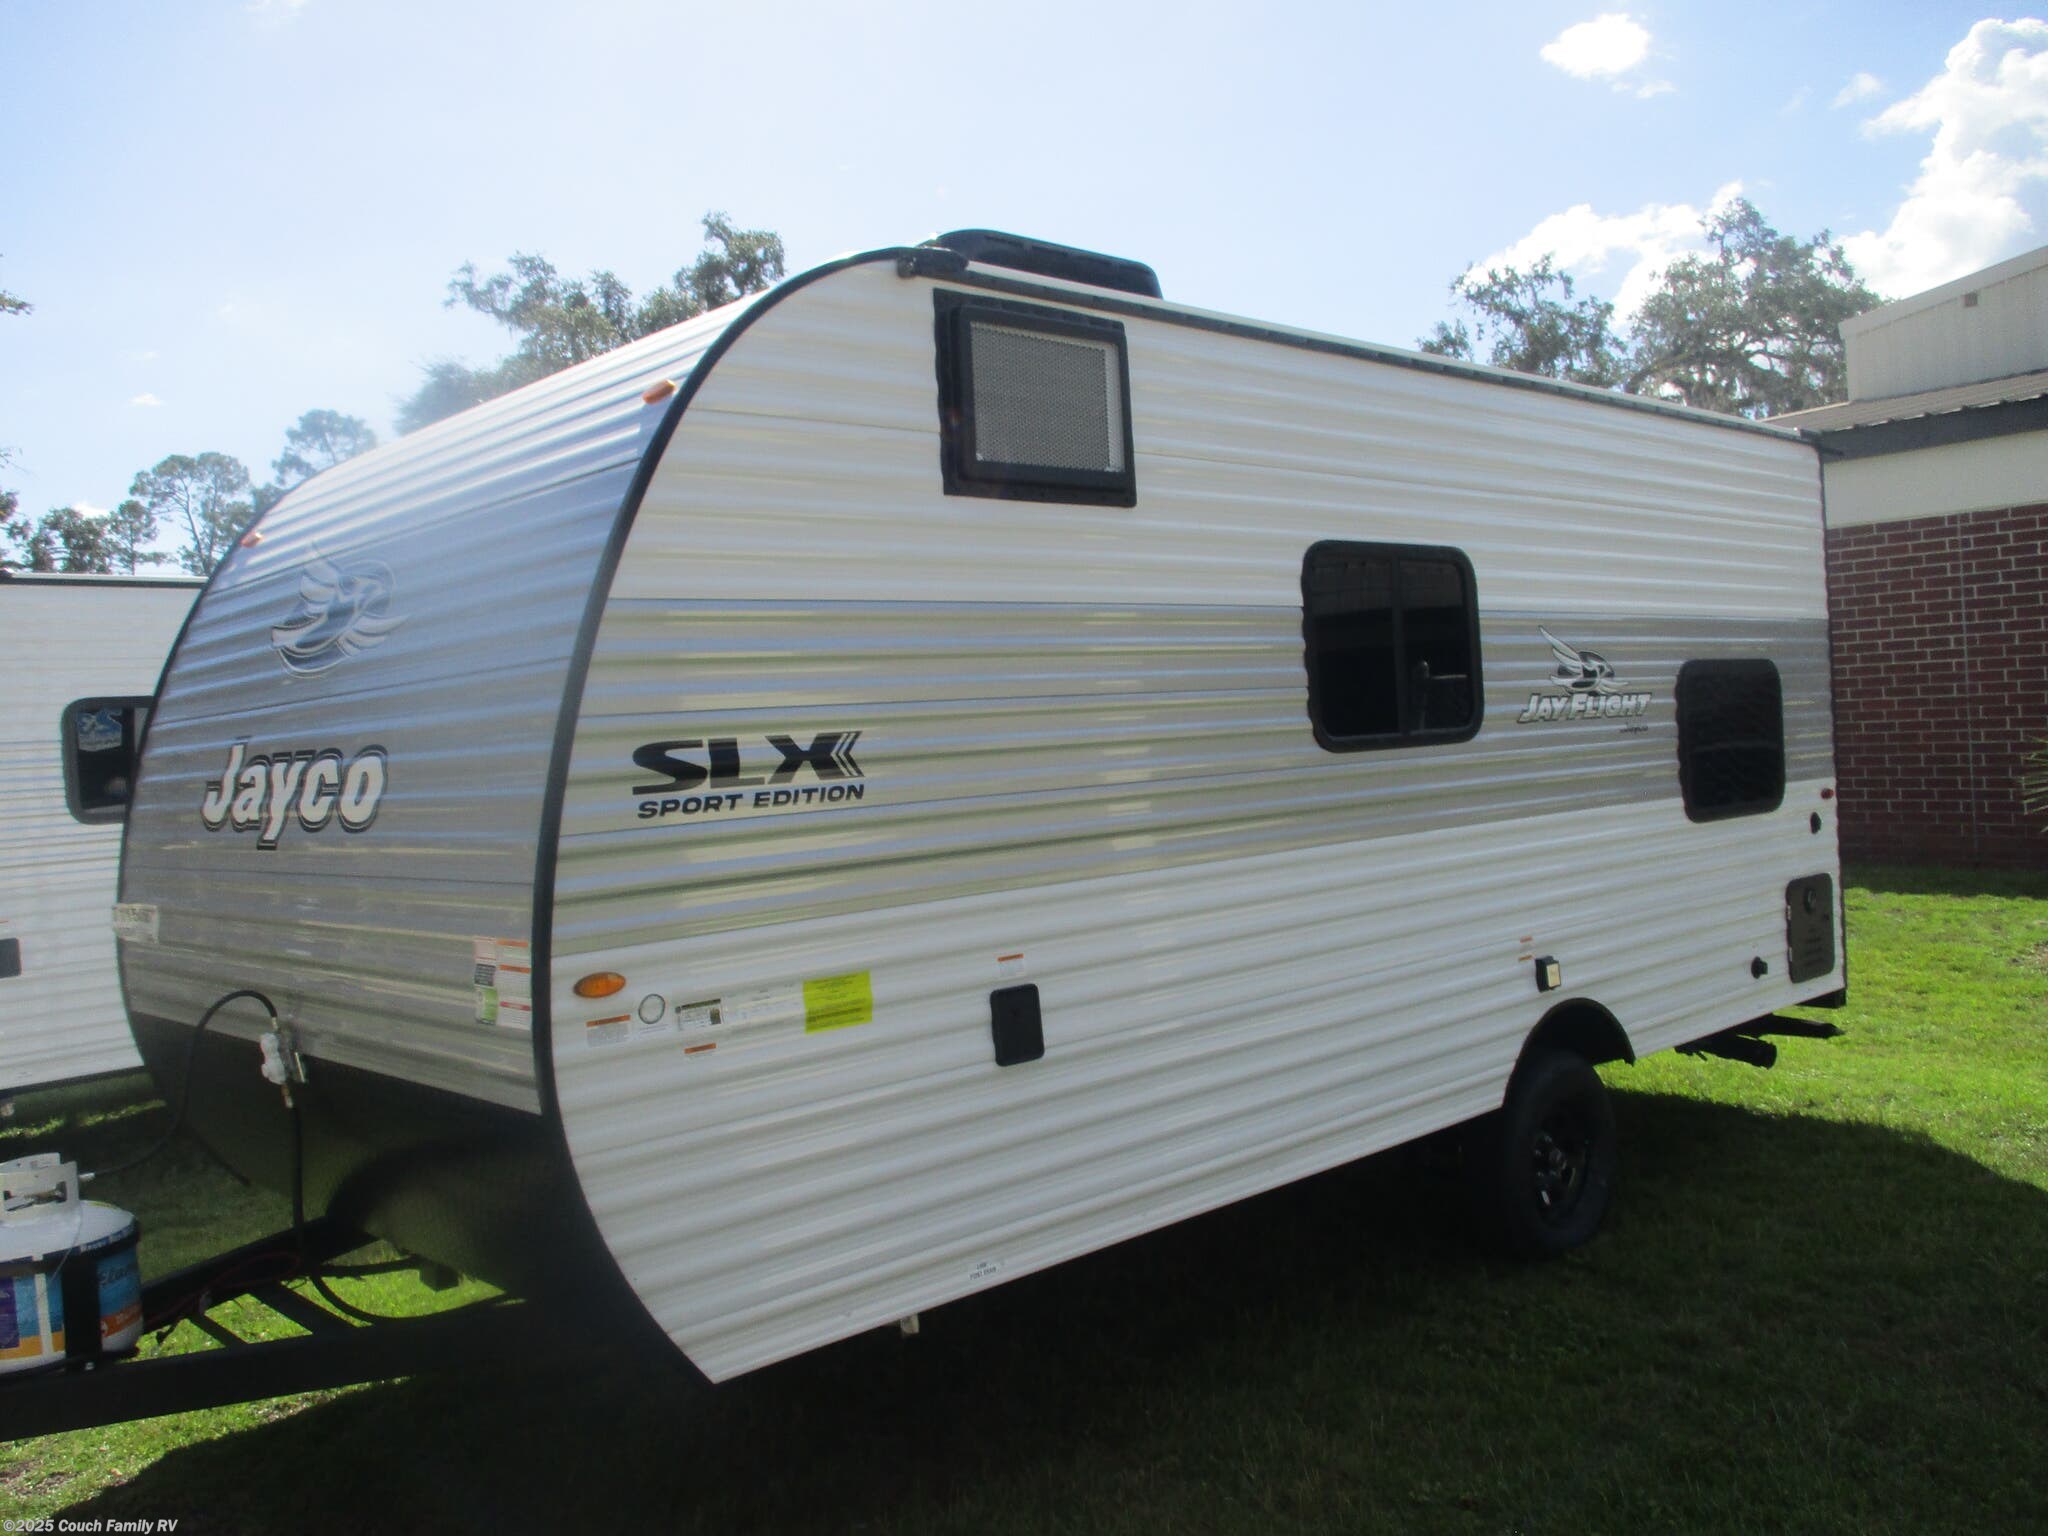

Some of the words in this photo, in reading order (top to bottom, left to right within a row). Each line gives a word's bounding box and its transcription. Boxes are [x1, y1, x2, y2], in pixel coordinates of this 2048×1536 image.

[1517, 693, 1569, 723] JAY
[1567, 692, 1652, 719] FLIGHT
[632, 730, 864, 795] SLX
[202, 736, 388, 850] Jayco
[637, 793, 743, 819] SPORT
[752, 784, 865, 809] EDITION
